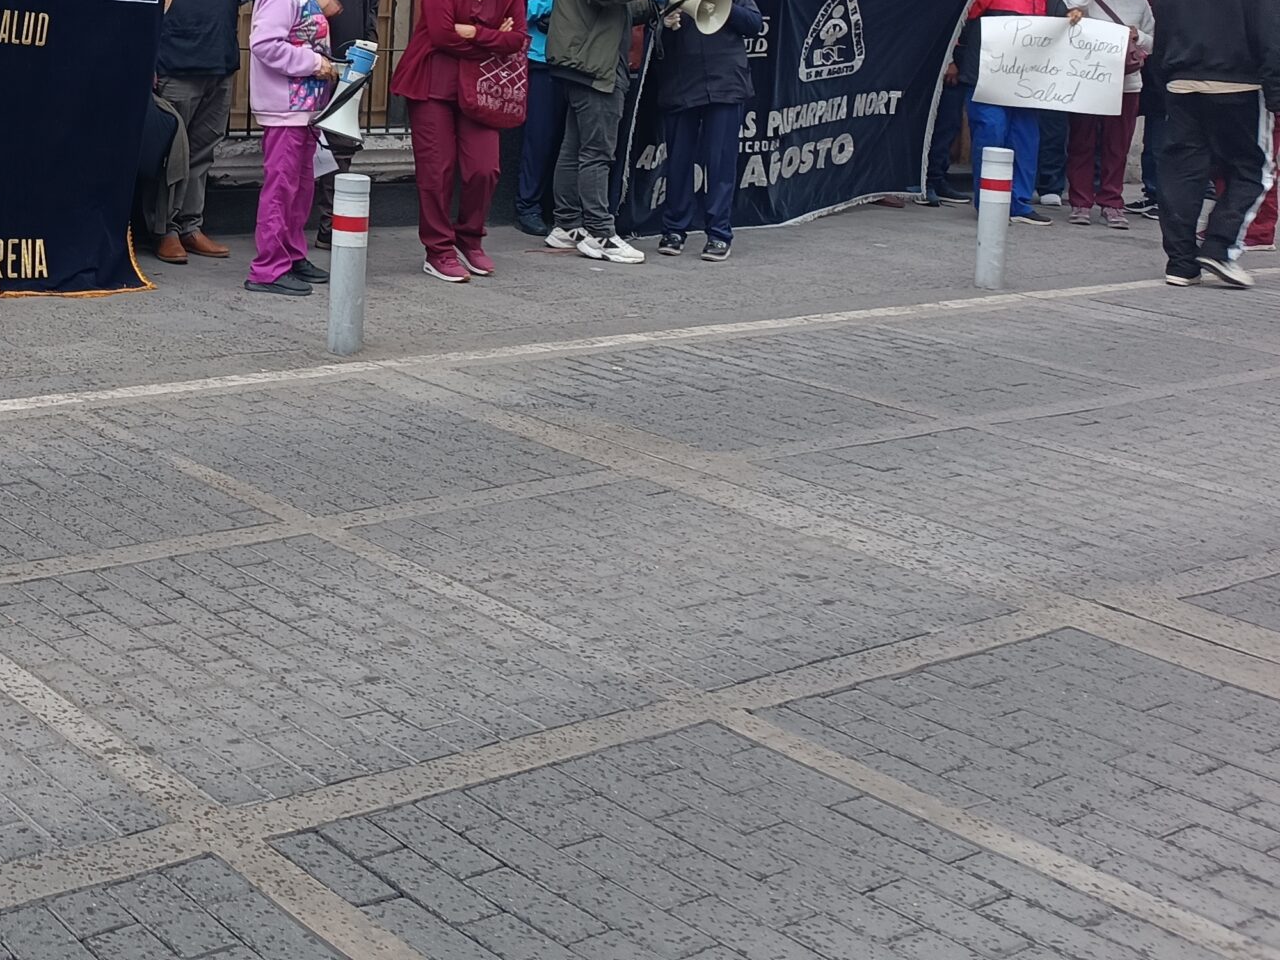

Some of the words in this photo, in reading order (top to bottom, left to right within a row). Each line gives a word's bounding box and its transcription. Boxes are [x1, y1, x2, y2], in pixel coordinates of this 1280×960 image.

[1004, 18, 1053, 47] Paro
[1068, 24, 1124, 60] Regional
[1014, 78, 1081, 104] Salud
[739, 132, 855, 189] AGOSTO
